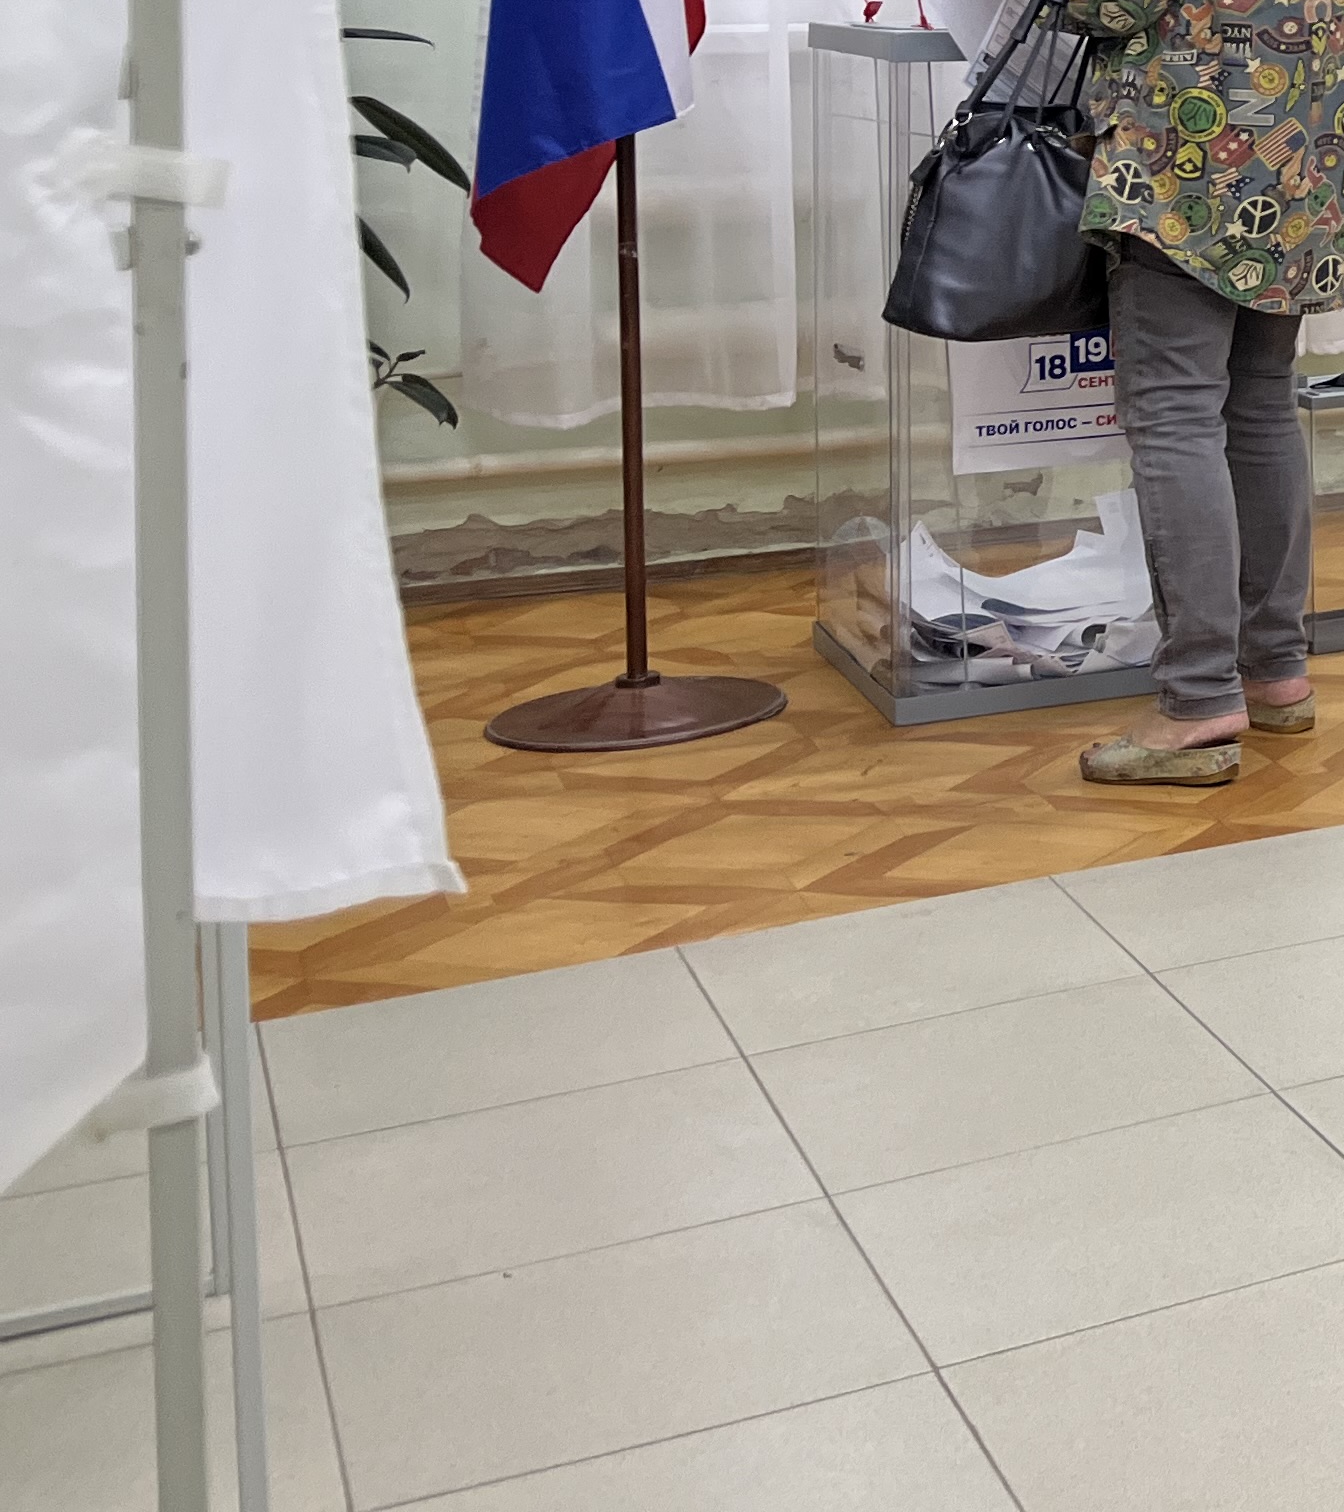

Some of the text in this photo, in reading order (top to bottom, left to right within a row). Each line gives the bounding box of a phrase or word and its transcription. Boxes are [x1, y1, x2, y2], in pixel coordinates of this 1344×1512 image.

[1223, 25, 1251, 38] NYC
[1035, 337, 1107, 380] 18 19
[975, 419, 1019, 437] ТВОЙ
[1024, 417, 1077, 433] ГОЛОС
